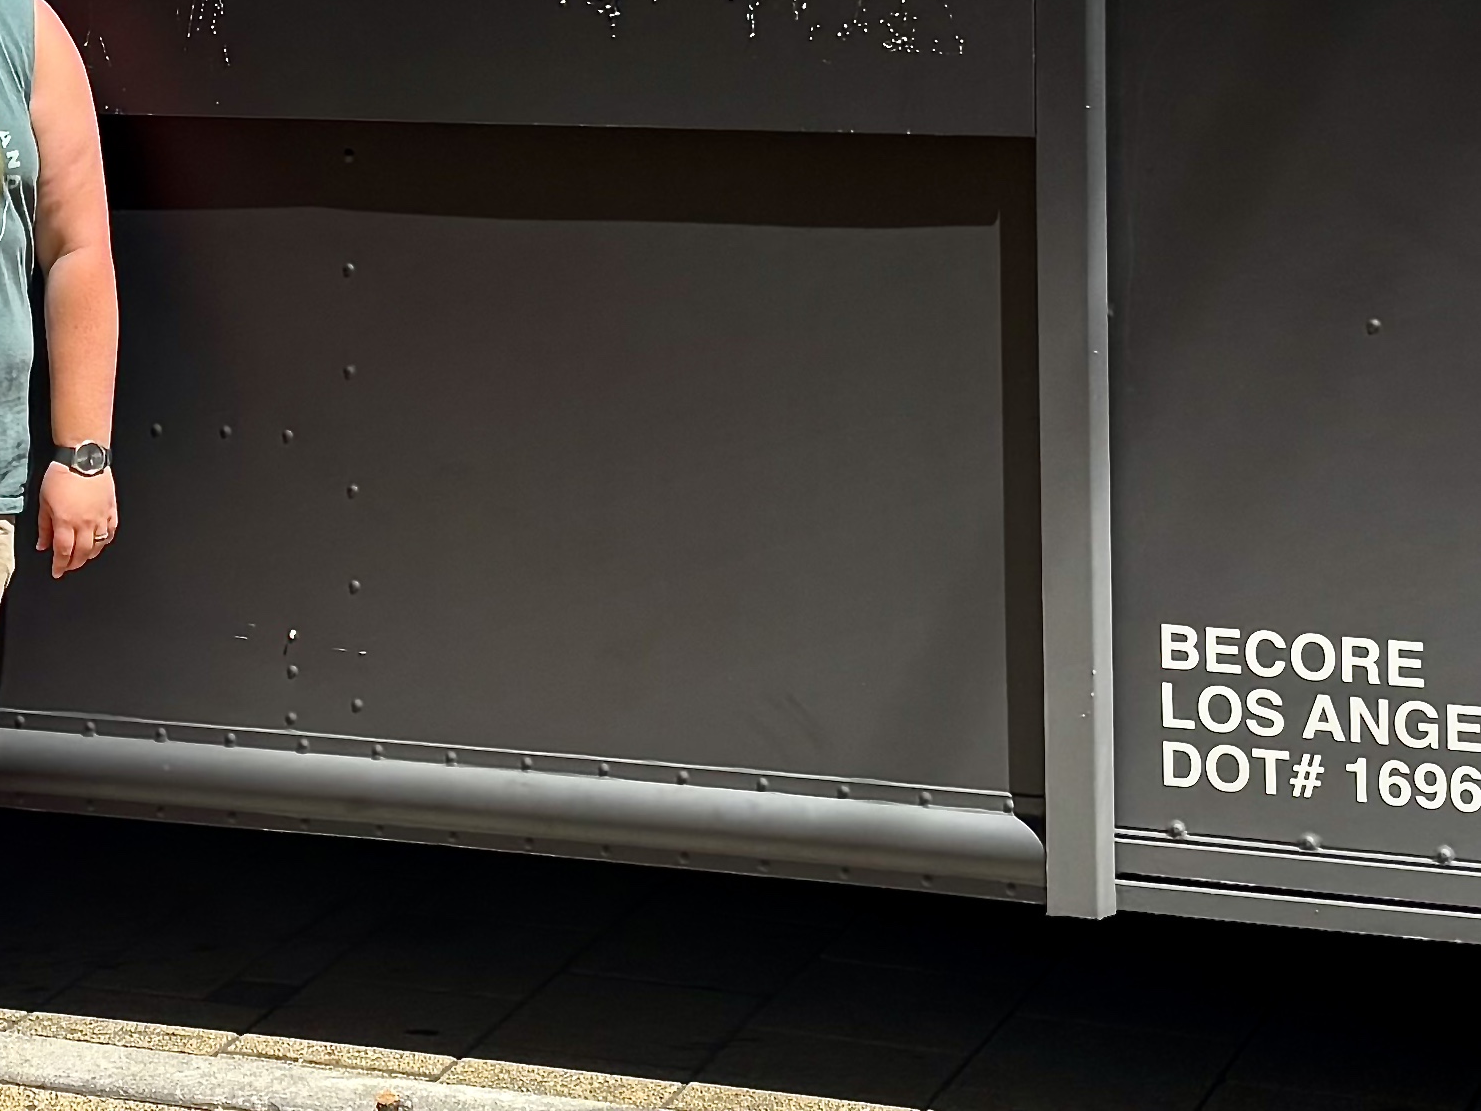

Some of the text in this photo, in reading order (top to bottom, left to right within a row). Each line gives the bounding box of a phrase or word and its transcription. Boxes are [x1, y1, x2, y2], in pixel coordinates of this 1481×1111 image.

[1160, 623, 1425, 689] BECORE
[1161, 681, 1481, 753] LOS ANGE
[1162, 740, 1481, 814] DOT# 1696
